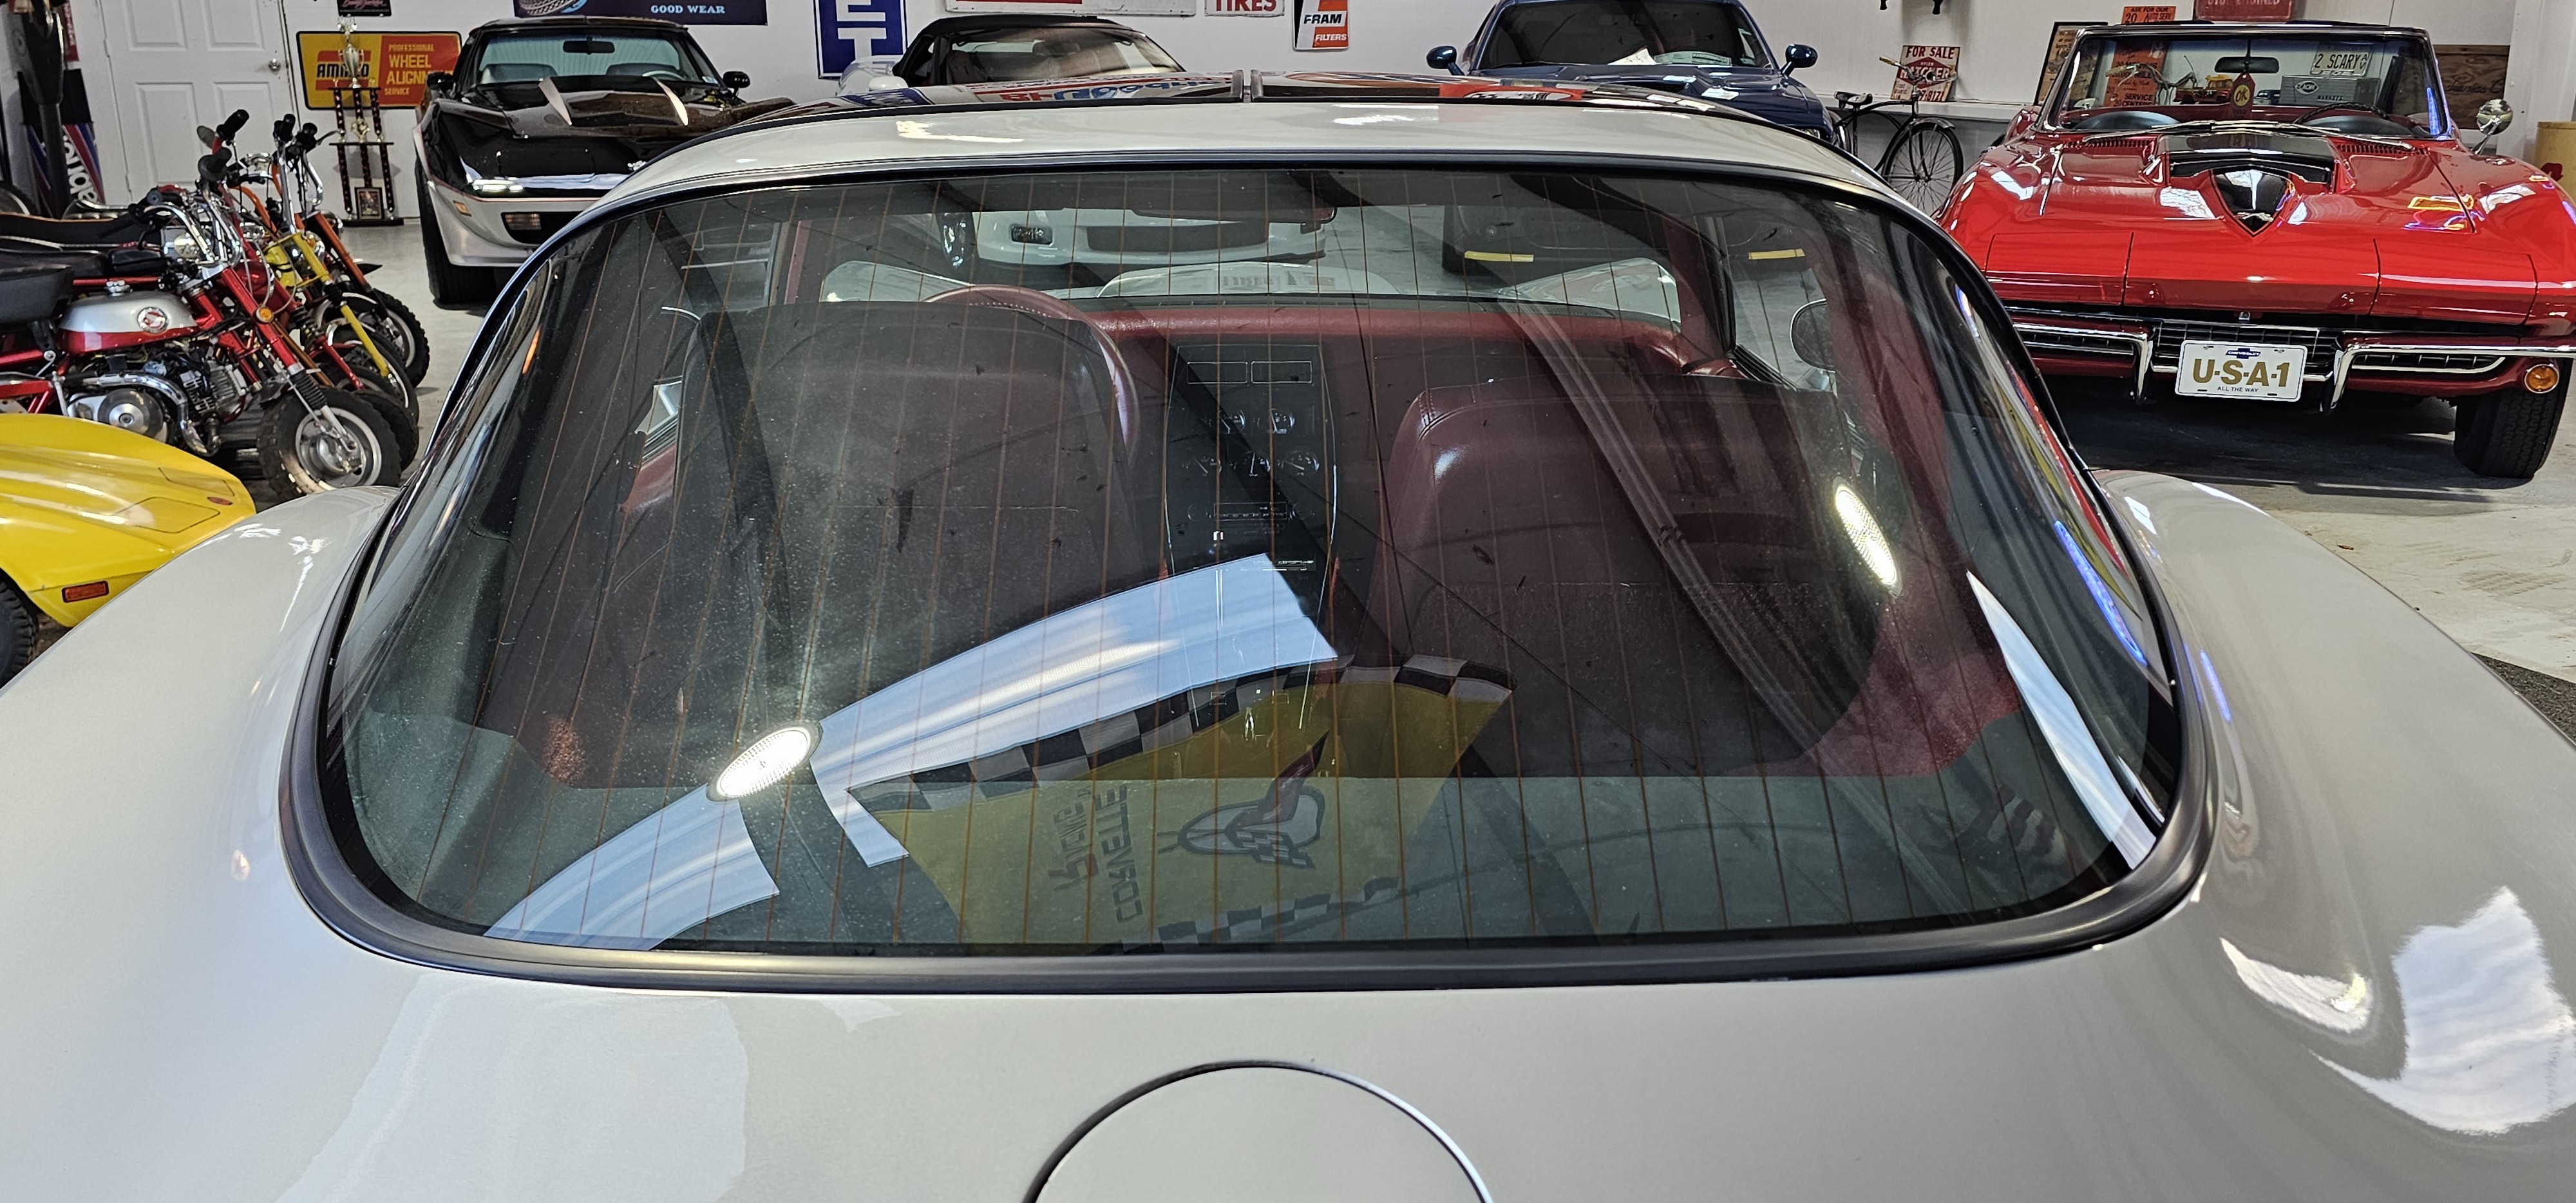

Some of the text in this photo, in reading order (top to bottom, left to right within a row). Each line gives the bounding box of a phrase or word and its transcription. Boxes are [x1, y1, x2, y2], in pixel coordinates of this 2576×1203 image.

[650, 5, 725, 14] GOOD WEAR
[1303, 14, 1342, 24] FRAM
[1906, 46, 1955, 59] FOR SALE
[389, 54, 431, 68] WHEEL
[2315, 53, 2324, 68] 2
[2327, 54, 2361, 69] SCARY
[317, 63, 370, 78] AMO
[2235, 87, 2248, 102] OK
